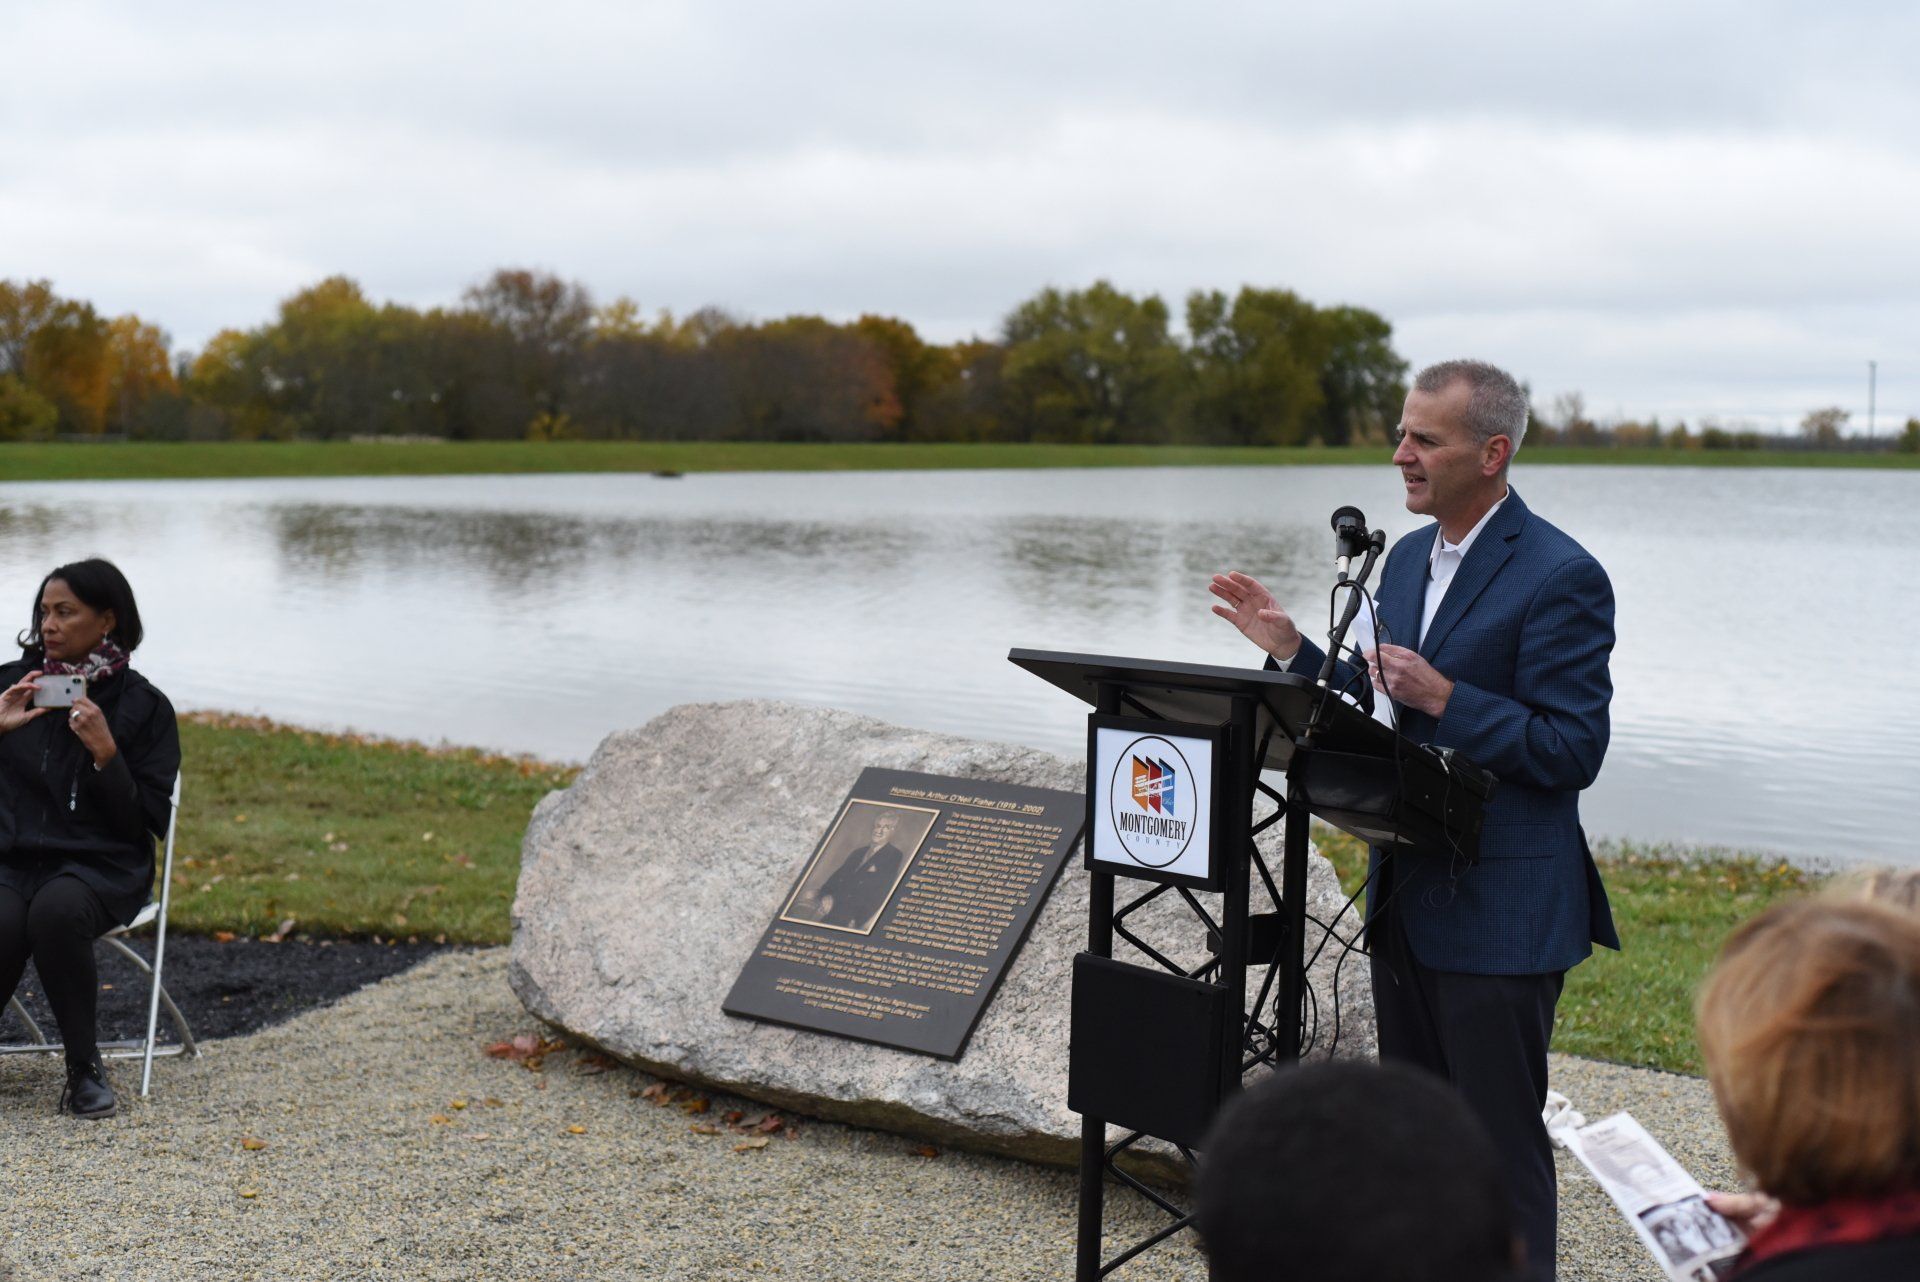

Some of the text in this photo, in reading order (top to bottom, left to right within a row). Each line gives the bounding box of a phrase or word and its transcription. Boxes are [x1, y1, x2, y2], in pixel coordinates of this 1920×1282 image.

[927, 792, 949, 801] Arthur
[972, 797, 996, 807] Fisher
[1120, 812, 1187, 840] MONTGOMERY
[1126, 834, 1181, 848] COUNTY
